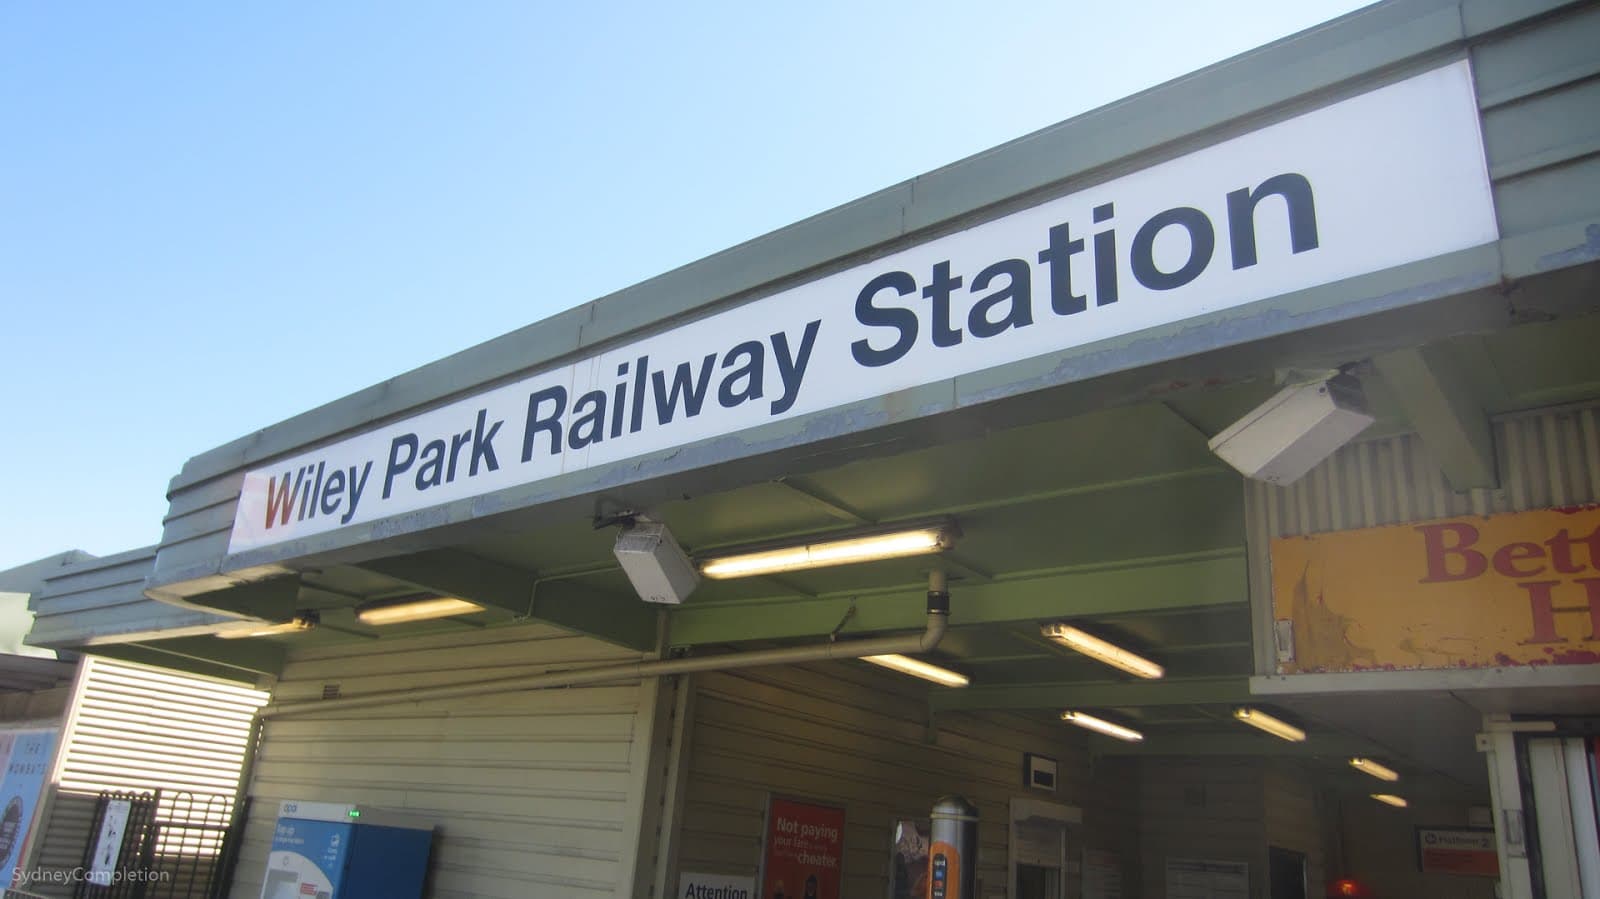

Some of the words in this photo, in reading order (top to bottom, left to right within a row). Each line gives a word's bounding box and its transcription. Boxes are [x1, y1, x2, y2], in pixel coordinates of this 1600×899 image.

[265, 460, 373, 529] Wiley
[382, 408, 505, 500] Park
[521, 319, 821, 463] Railway
[851, 173, 1319, 368] Station
[777, 817, 799, 834] Not
[801, 822, 838, 843] paying
[774, 836, 792, 847] your
[792, 836, 810, 848] fare
[685, 882, 748, 899] Attention
